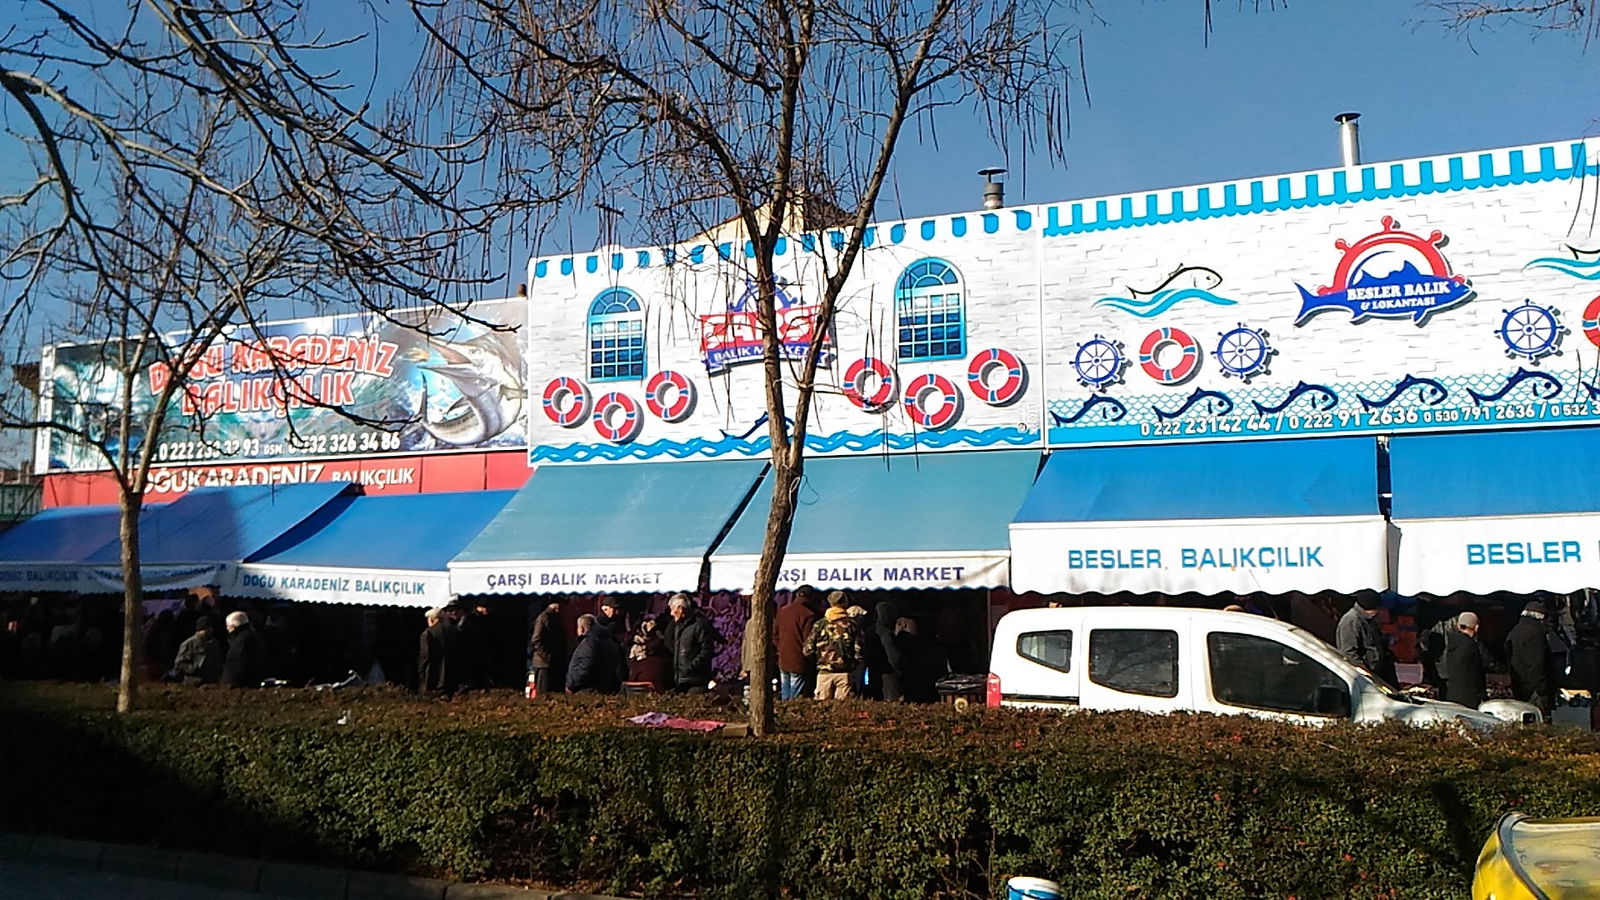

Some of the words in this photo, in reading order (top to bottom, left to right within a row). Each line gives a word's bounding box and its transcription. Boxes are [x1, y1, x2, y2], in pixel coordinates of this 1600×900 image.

[1347, 285, 1402, 300] BESLER
[1404, 281, 1451, 296] BALIK
[1360, 301, 1370, 310] &
[1372, 297, 1436, 309] LOKANTASI
[232, 333, 399, 377] KARADENİZ
[182, 371, 355, 418] BALIKÇILIK
[1140, 422, 1150, 436] 0
[1153, 421, 1181, 436] 222
[1289, 414, 1299, 430] 0
[1303, 413, 1333, 429] 222
[1337, 409, 1361, 427] 91
[1368, 405, 1418, 426] 2636
[1423, 411, 1432, 423] 0
[1434, 409, 1459, 422] 530
[1461, 405, 1490, 421] 791
[1495, 404, 1536, 420] 2636
[1551, 404, 1560, 417] 0
[1563, 403, 1589, 417] 532
[159, 443, 168, 461] 0
[170, 441, 194, 460] 222
[242, 438, 260, 456] 93
[329, 433, 357, 452] 326
[359, 432, 378, 451] 34
[380, 431, 401, 450] 86
[332, 467, 415, 489] BALIKÇILIK
[1068, 548, 1162, 569] BESLER
[1181, 546, 1324, 572] BALIKÇILIK
[1466, 541, 1581, 565] BESLER
[243, 573, 275, 588] DOĞU
[280, 576, 350, 592] KARADENİZ
[355, 579, 425, 597] BALIKÇILIK
[540, 573, 587, 586] BALIK
[595, 571, 663, 585] MARKET
[817, 568, 873, 582] BALIK
[883, 566, 965, 581] MARKET
